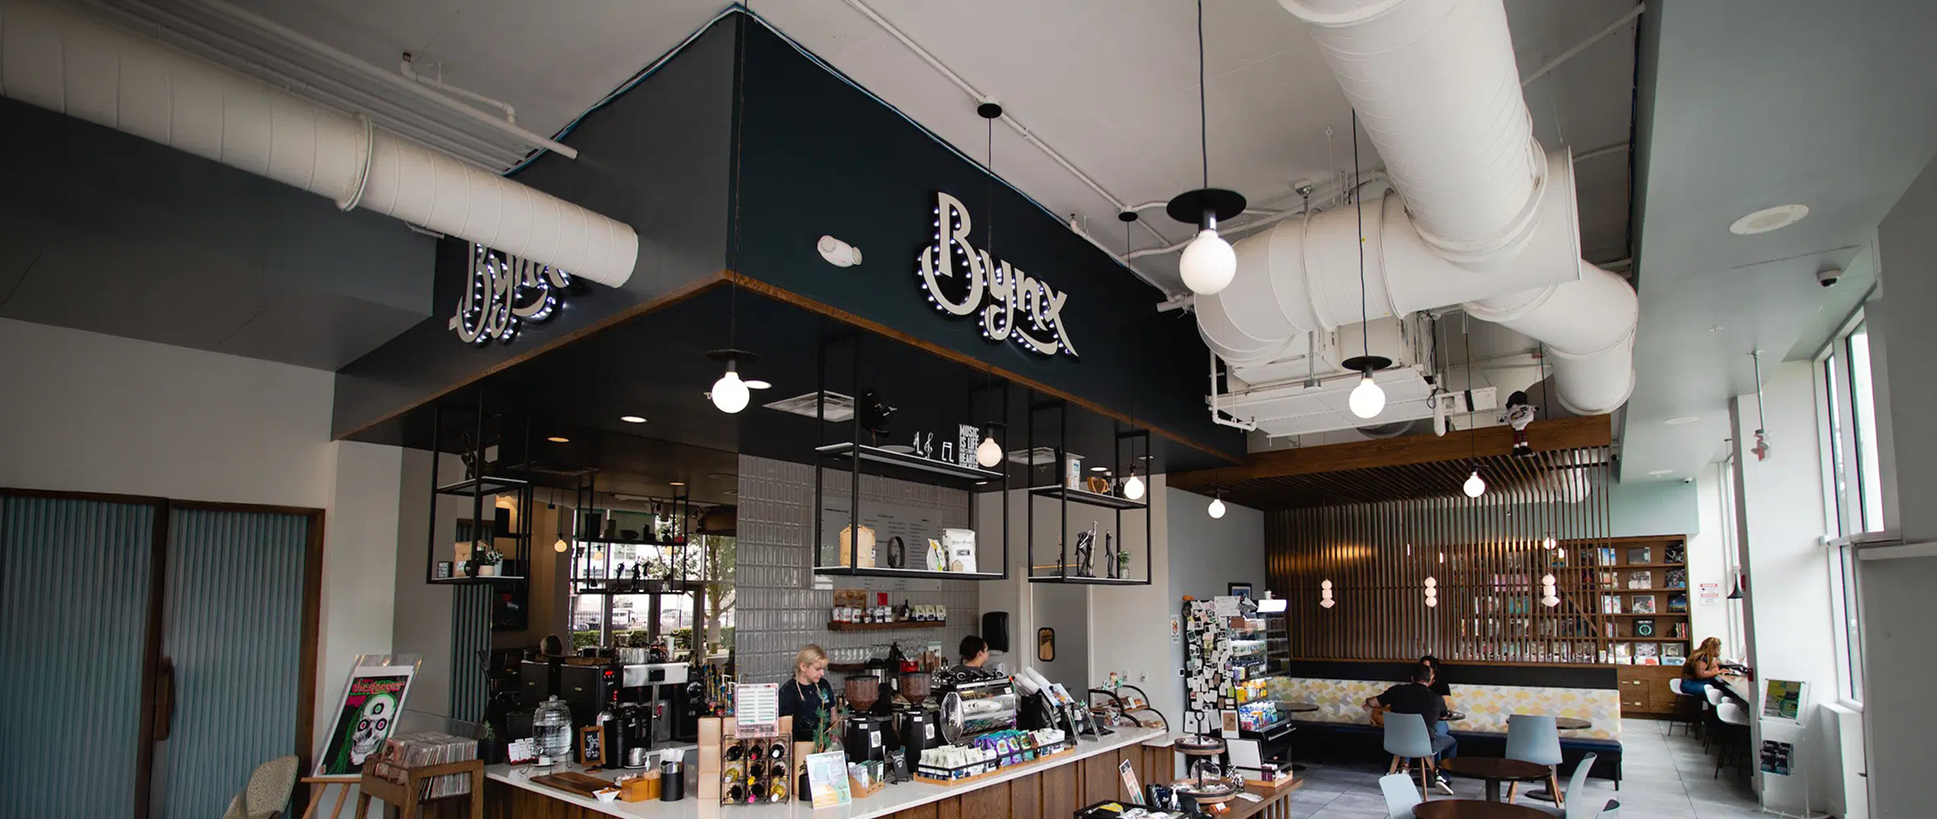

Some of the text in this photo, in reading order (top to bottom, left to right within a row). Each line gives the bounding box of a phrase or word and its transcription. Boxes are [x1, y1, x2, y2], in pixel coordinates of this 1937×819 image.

[921, 191, 1079, 357] Bynx
[959, 423, 980, 438] MUSIC
[959, 436, 980, 450] IS LIFE
